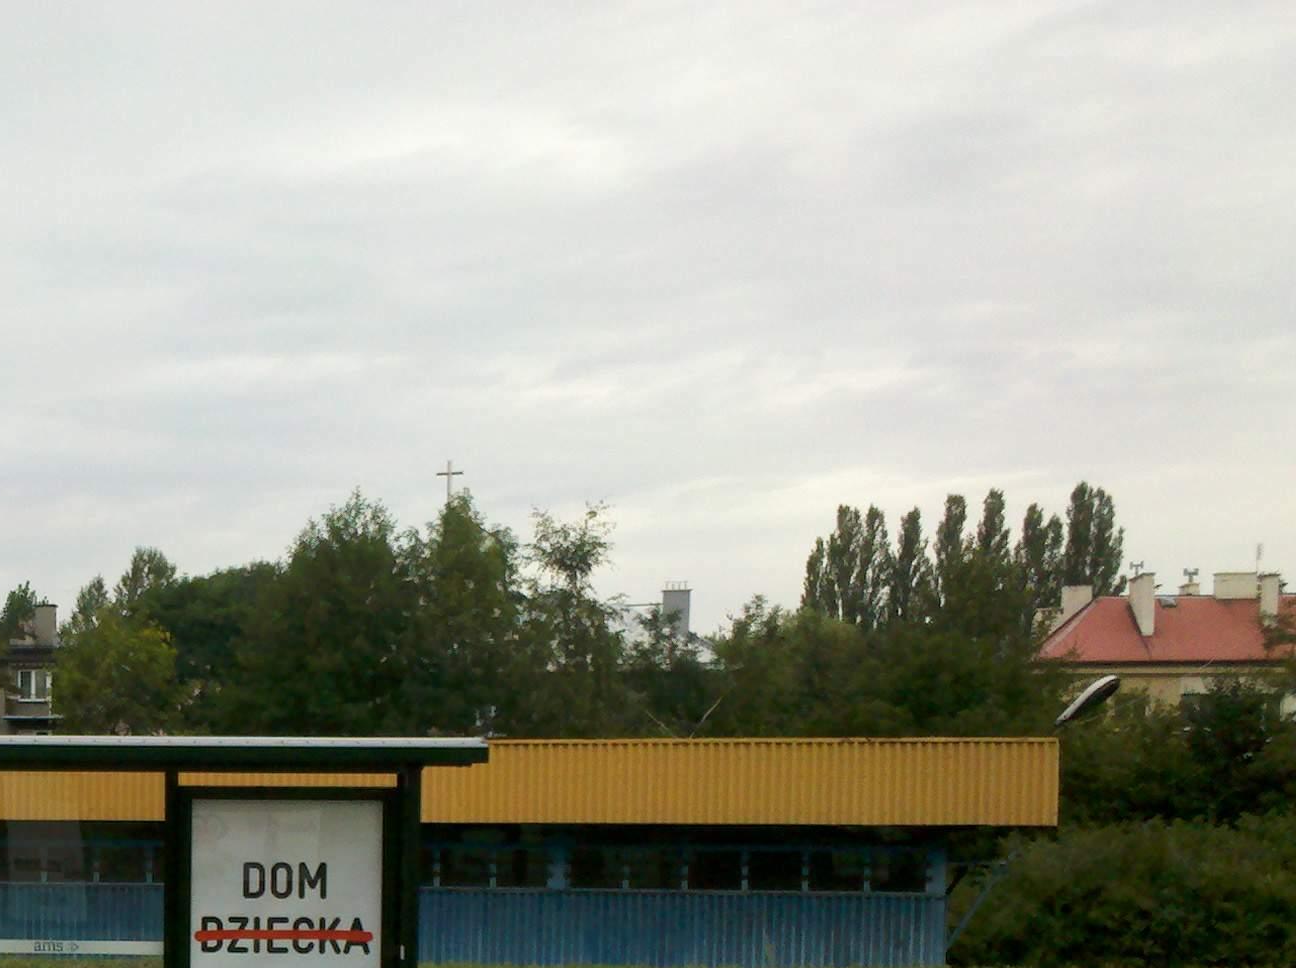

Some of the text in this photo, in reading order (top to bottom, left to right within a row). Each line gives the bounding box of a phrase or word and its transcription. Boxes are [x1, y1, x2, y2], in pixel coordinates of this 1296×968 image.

[242, 862, 328, 899] DOM
[33, 941, 64, 952] ams
[200, 916, 371, 954] DZIECKA
